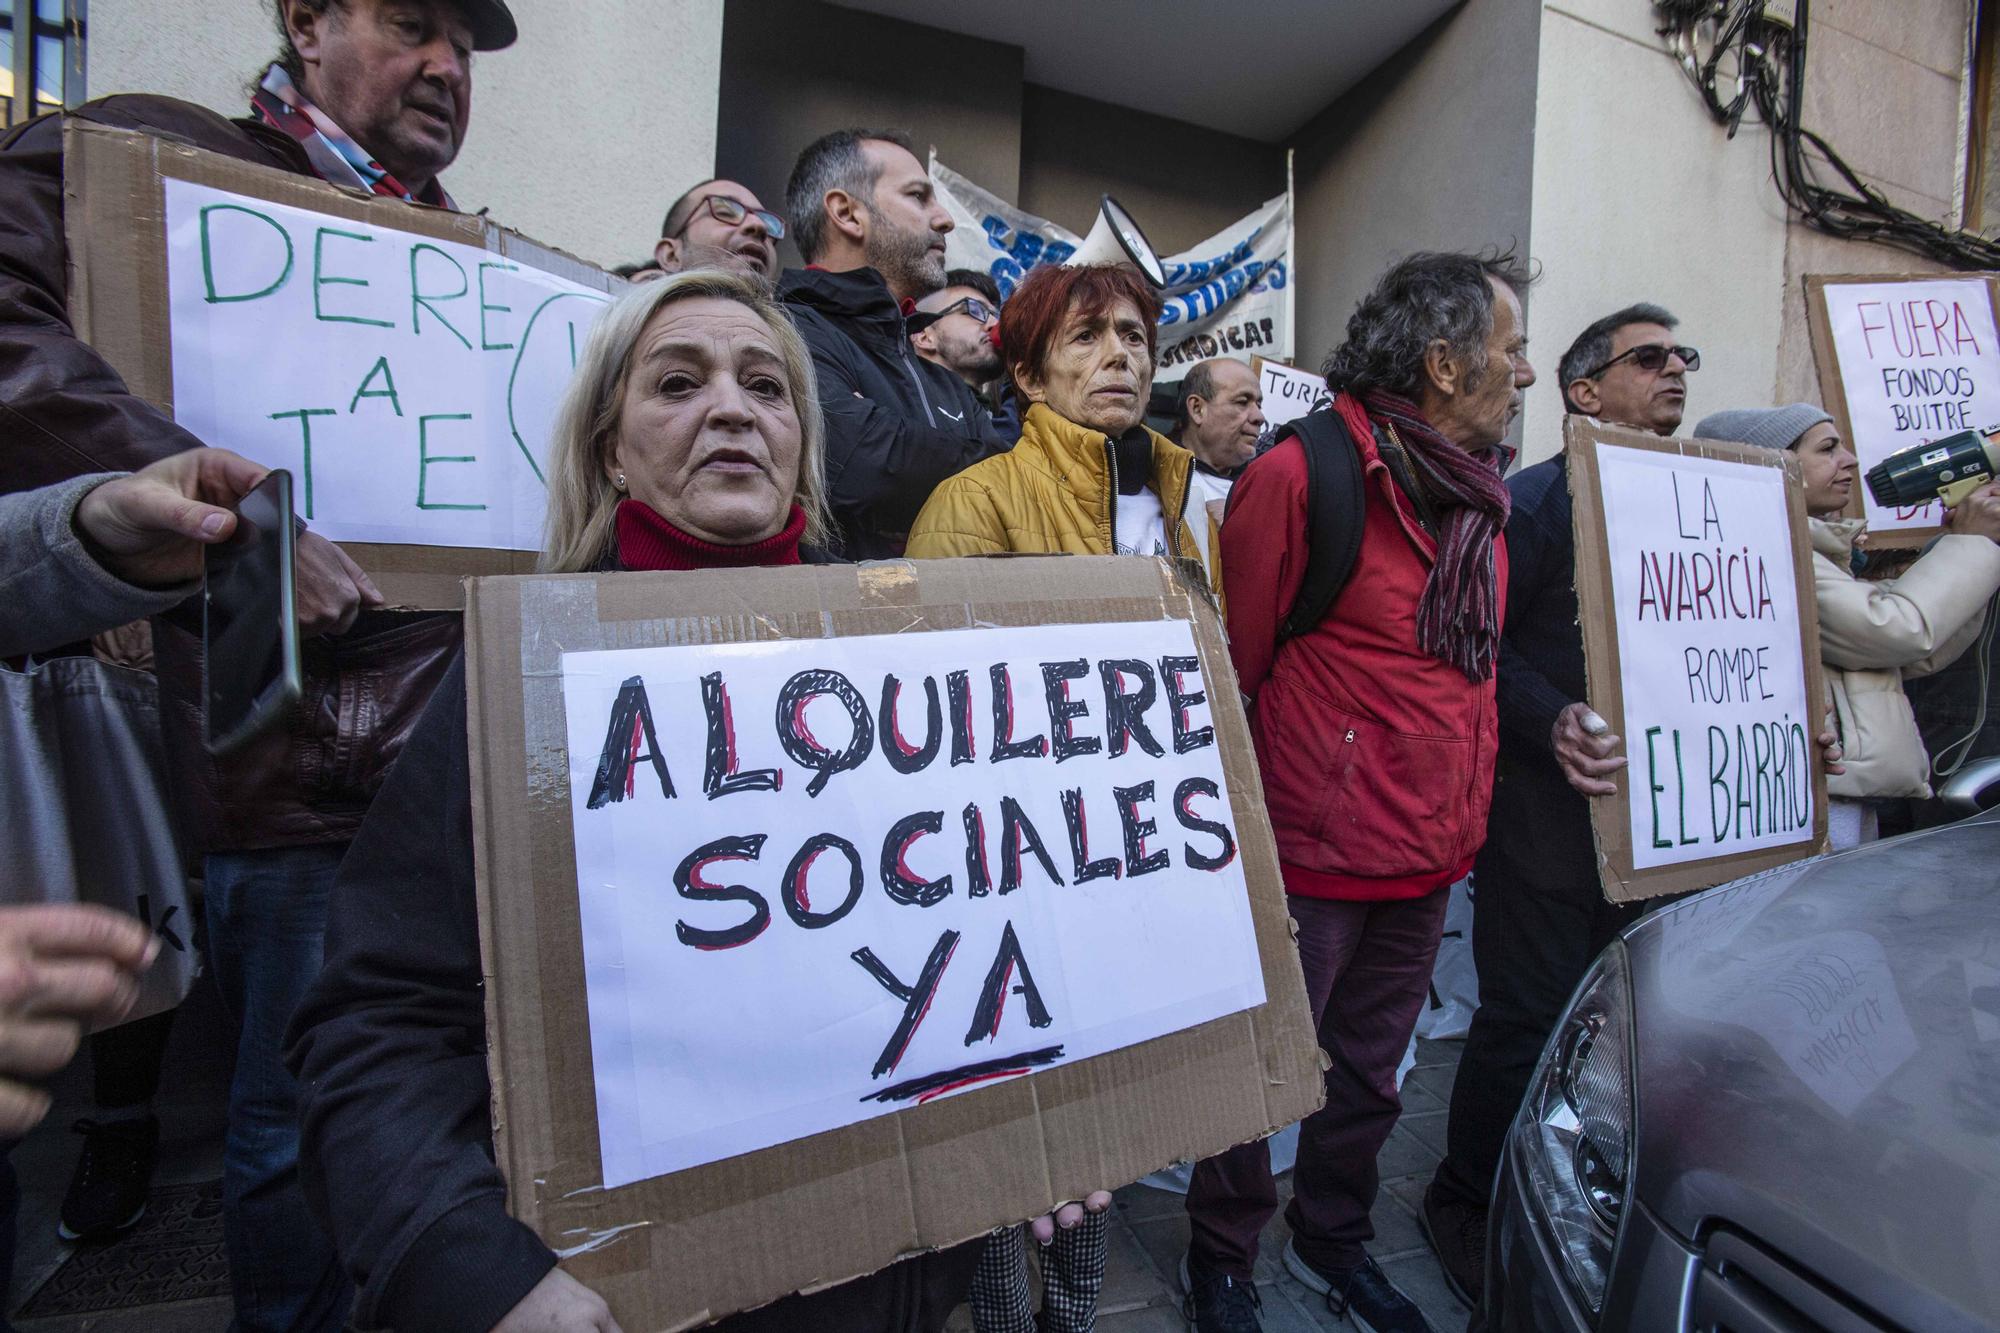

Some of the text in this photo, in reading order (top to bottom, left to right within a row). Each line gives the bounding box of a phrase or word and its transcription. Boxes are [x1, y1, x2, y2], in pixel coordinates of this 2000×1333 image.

[1857, 299, 1980, 359] FUERA
[350, 356, 403, 416] A
[1882, 366, 1974, 398] FONDOS
[1889, 400, 1975, 431] BUITRE
[1672, 471, 1723, 542] LA
[1684, 646, 1774, 704] ROMPE
[587, 655, 1214, 809] ALQUILERE
[1646, 725, 1699, 849] EL
[673, 777, 1237, 951] SOCIALES
[850, 919, 1053, 1079] YA
